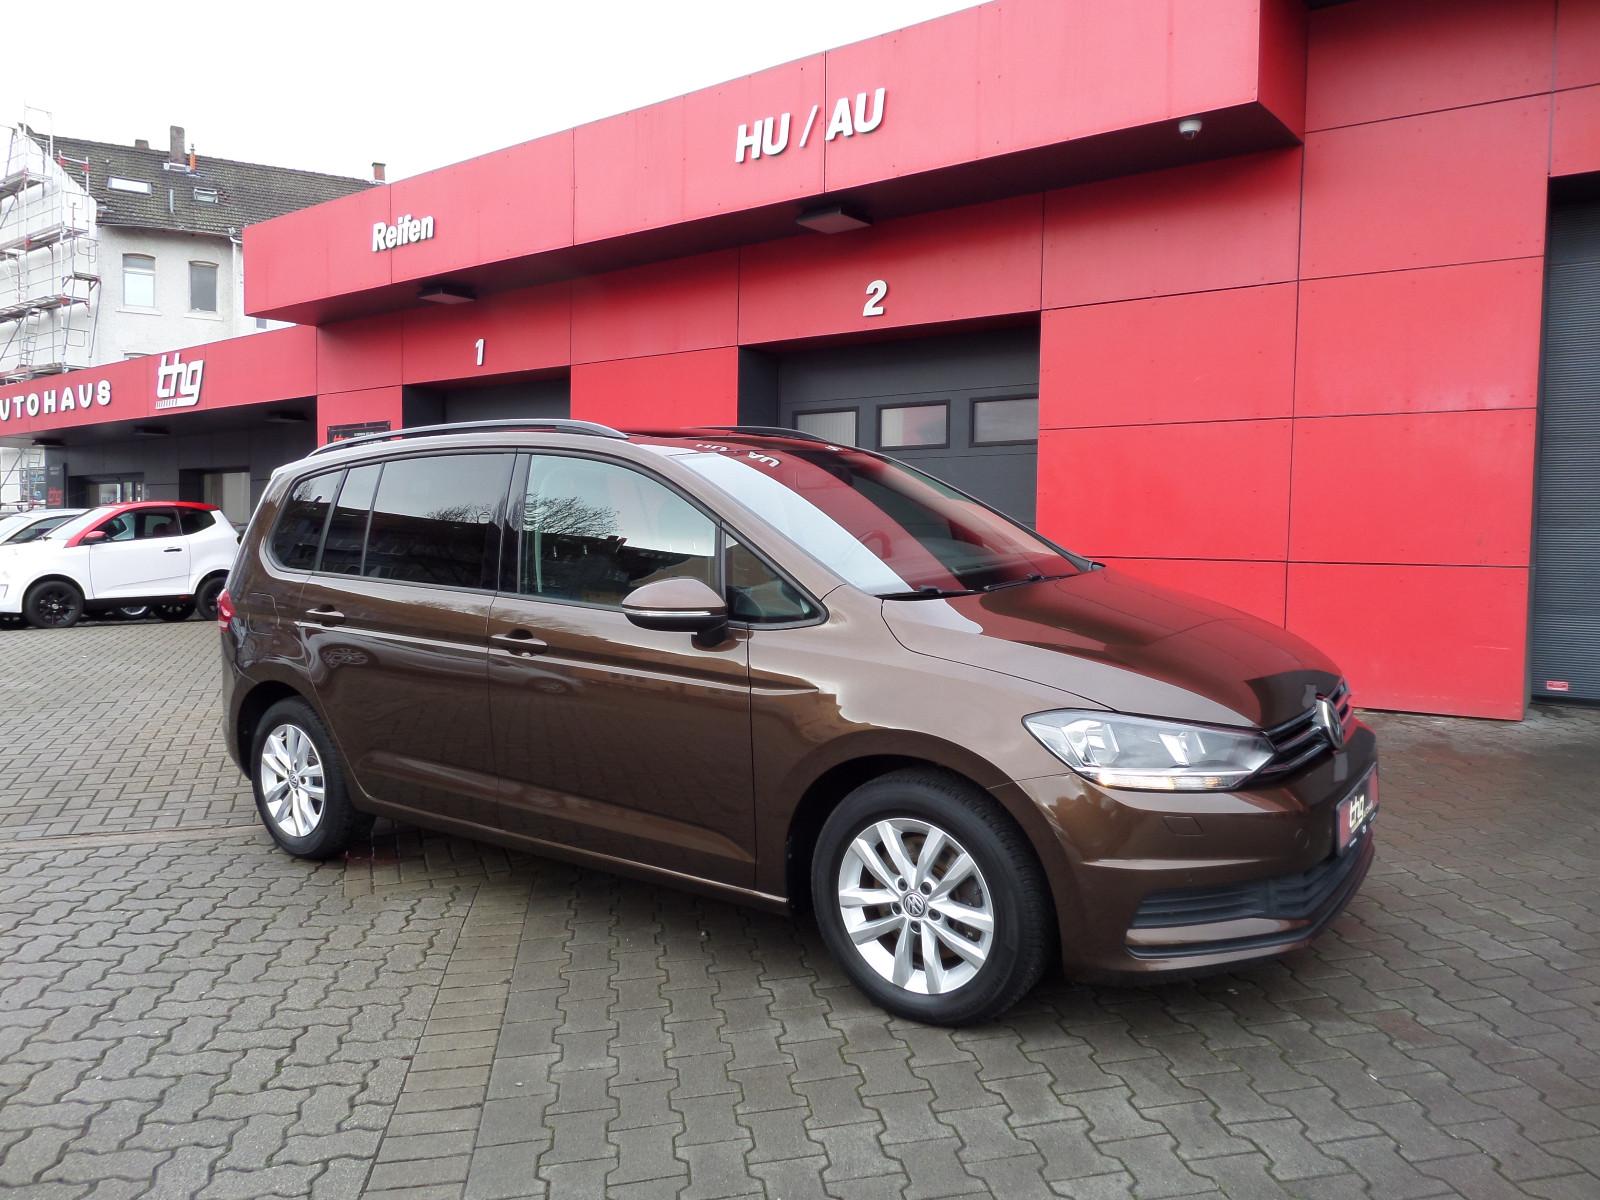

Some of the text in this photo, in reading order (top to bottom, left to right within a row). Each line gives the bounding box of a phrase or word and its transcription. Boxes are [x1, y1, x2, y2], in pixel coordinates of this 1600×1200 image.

[735, 87, 886, 163] HU / AU
[372, 214, 434, 251] Reifen
[863, 279, 888, 317] 2
[475, 338, 485, 366] 1
[0, 352, 204, 421] UTOHAUS thg
